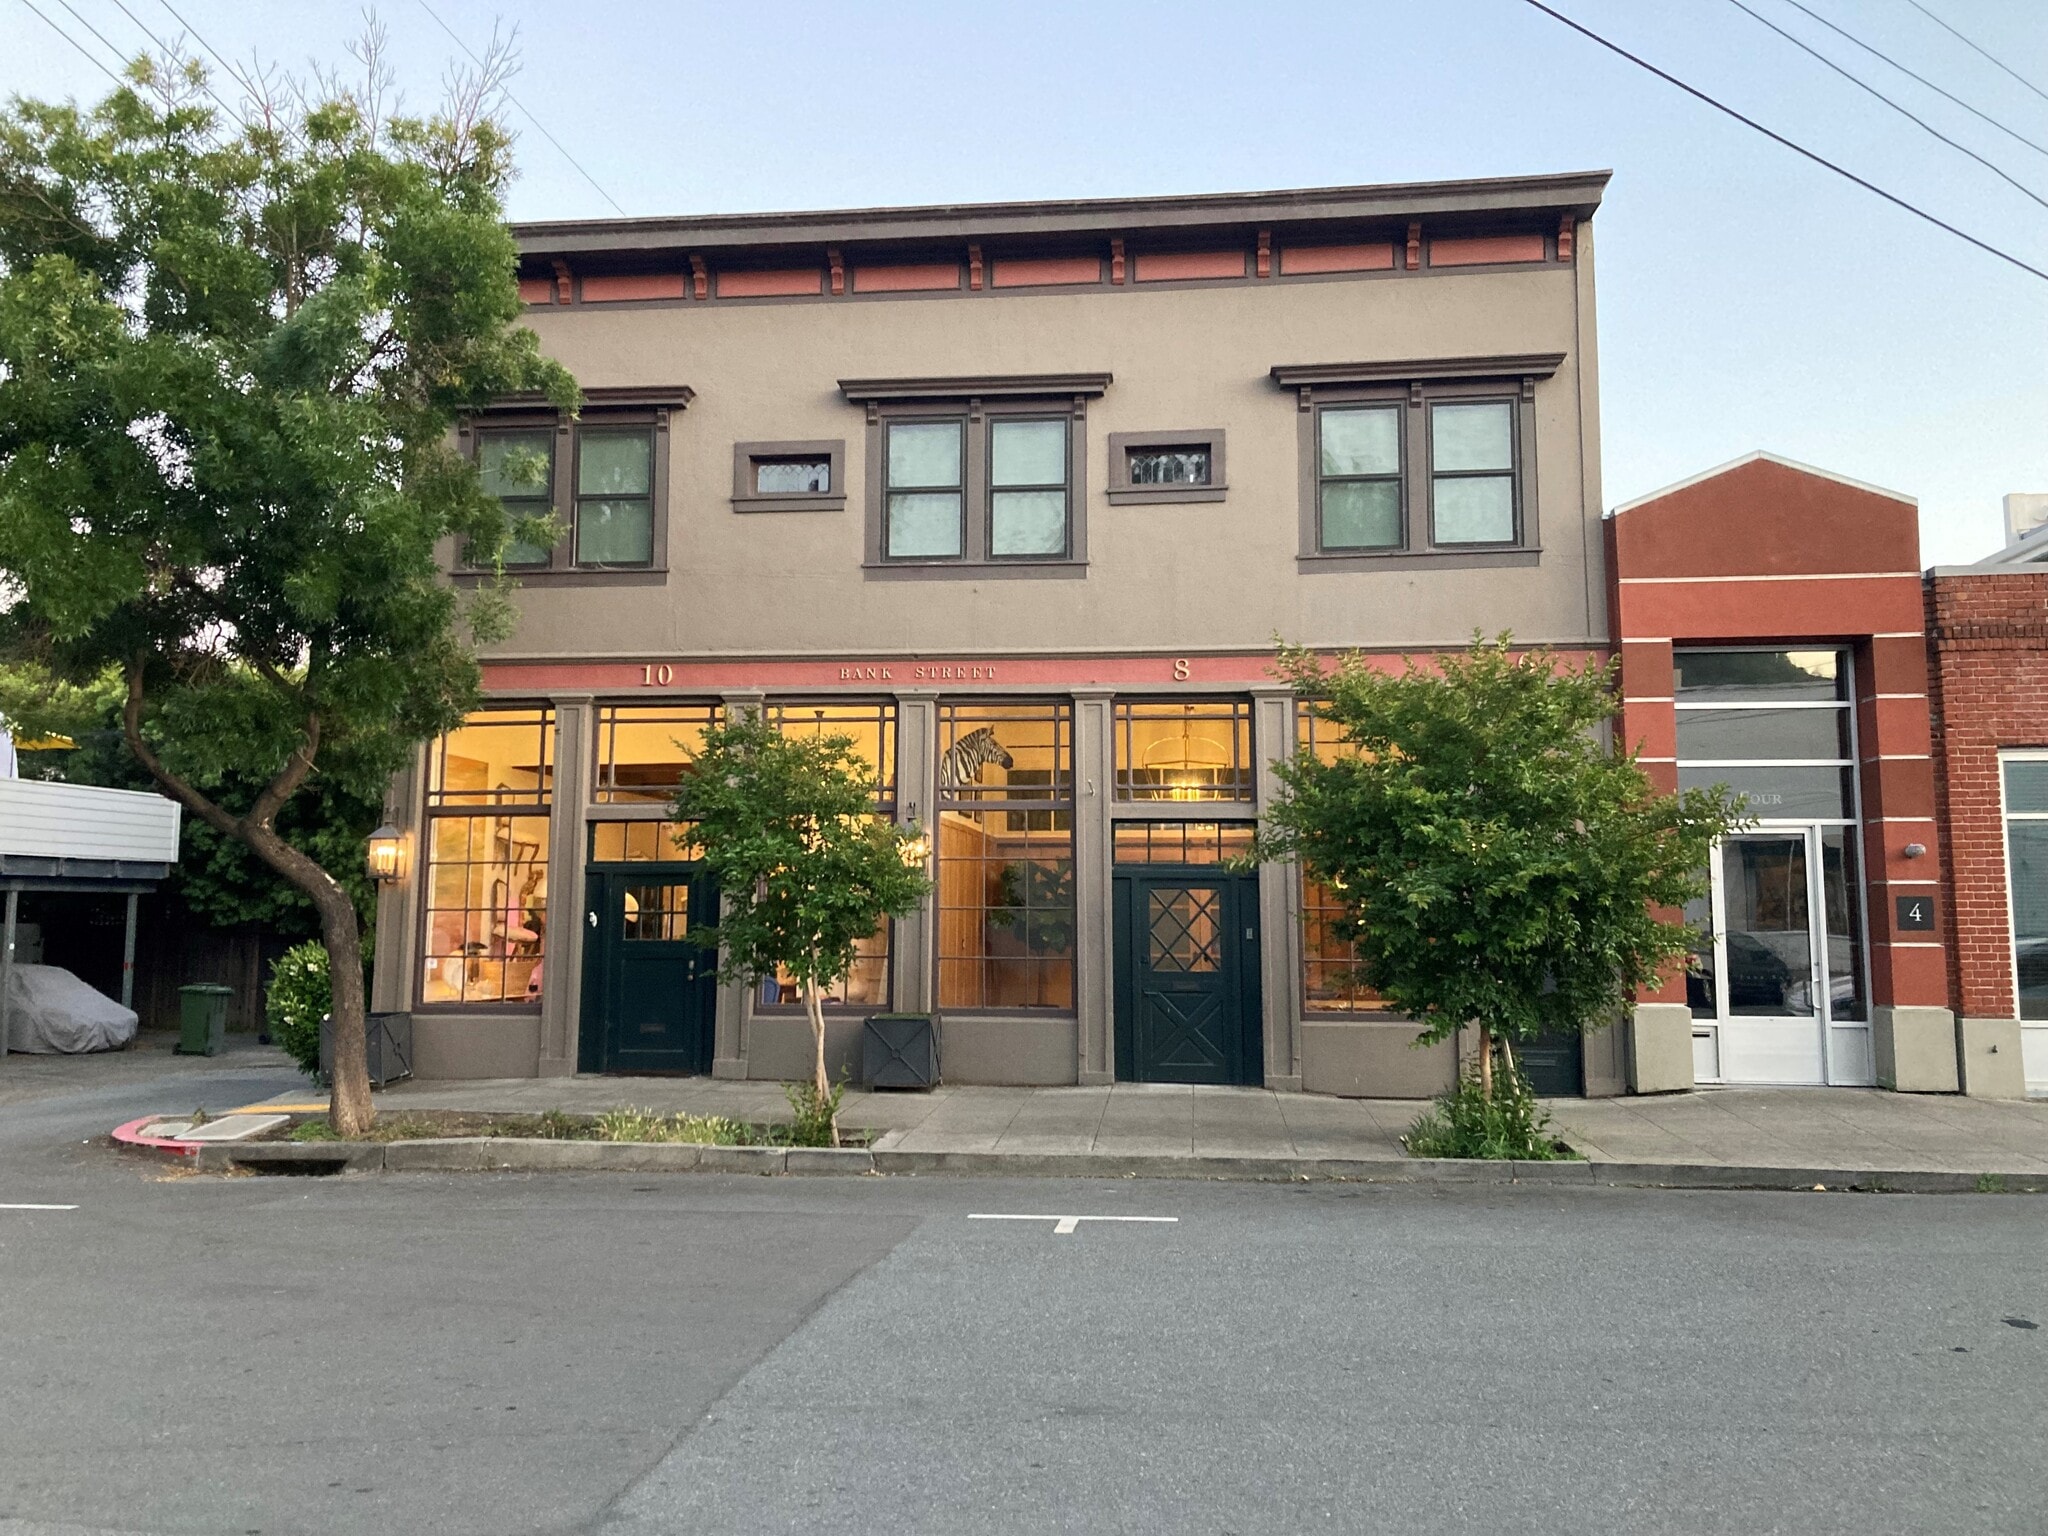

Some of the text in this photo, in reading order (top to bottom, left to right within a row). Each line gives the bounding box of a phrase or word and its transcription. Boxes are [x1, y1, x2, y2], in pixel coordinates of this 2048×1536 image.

[641, 664, 673, 686] 10
[840, 666, 996, 680] BANK STREET
[1173, 658, 1190, 681] 8
[1909, 902, 1922, 922] 4
